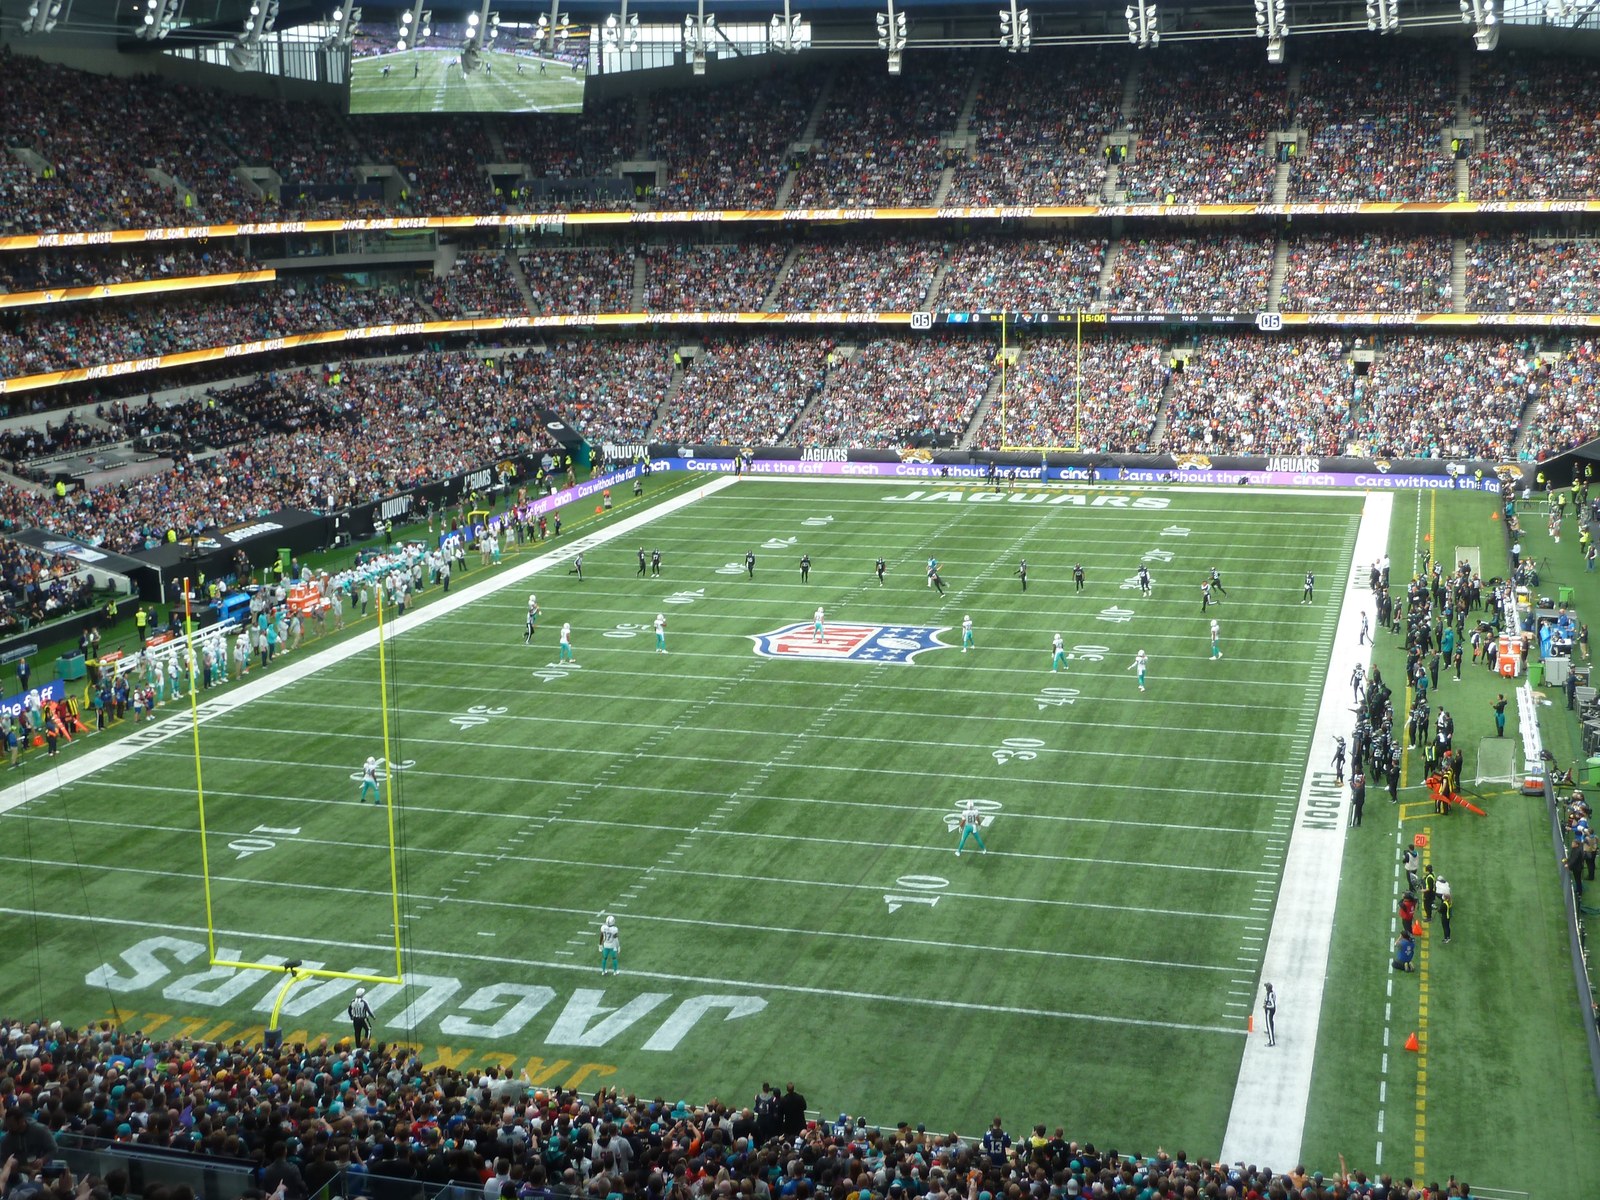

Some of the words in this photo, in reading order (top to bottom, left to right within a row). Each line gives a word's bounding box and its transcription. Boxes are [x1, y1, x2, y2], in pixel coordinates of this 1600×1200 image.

[1098, 206, 1126, 216] MAKE
[1131, 205, 1158, 216] SOME
[1254, 204, 1284, 214] MAKE
[1290, 203, 1318, 214] SOME
[1477, 202, 1507, 212] MAKE
[1513, 202, 1544, 212] SOME
[912, 314, 930, 326] 06
[1081, 314, 1105, 323] 15:00
[1261, 315, 1278, 327] 06
[1307, 313, 1338, 323] MAKE
[1343, 313, 1373, 323] SOME
[1476, 315, 1509, 324] MAKE
[1514, 315, 1545, 324] SOME
[605, 446, 648, 459] UUUVA
[800, 449, 848, 462] JAGUARS
[641, 460, 670, 473] cnch
[686, 460, 717, 471] Cars
[721, 460, 771, 472] wihout
[773, 461, 796, 473] the
[798, 462, 823, 473] faff
[841, 463, 879, 475] cinch
[895, 464, 928, 476] Cars
[930, 465, 986, 478] wthout
[1014, 467, 1041, 478] faff
[1266, 457, 1320, 472] JAGUARS
[1118, 470, 1153, 481] Cars
[1156, 471, 1211, 483] wthout
[1217, 471, 1238, 483] the
[1293, 473, 1335, 485] cinch
[1354, 475, 1398, 487] Cars
[1400, 475, 1455, 488] without
[1459, 478, 1482, 489] th
[577, 485, 593, 498] Cars
[592, 476, 615, 492] without
[881, 491, 1172, 509] JAGUARS
[382, 496, 409, 520] DUUUV
[1503, 663, 1512, 672] G
[0, 702, 21, 716] he
[24, 686, 53, 707] fff
[118, 703, 233, 746] LONDON
[1302, 771, 1342, 830] LONDON
[967, 814, 976, 825] 81
[1415, 836, 1425, 845] 20
[604, 932, 616, 941] 17
[85, 935, 769, 1051] JAGUARS
[990, 1141, 1002, 1154] 13
